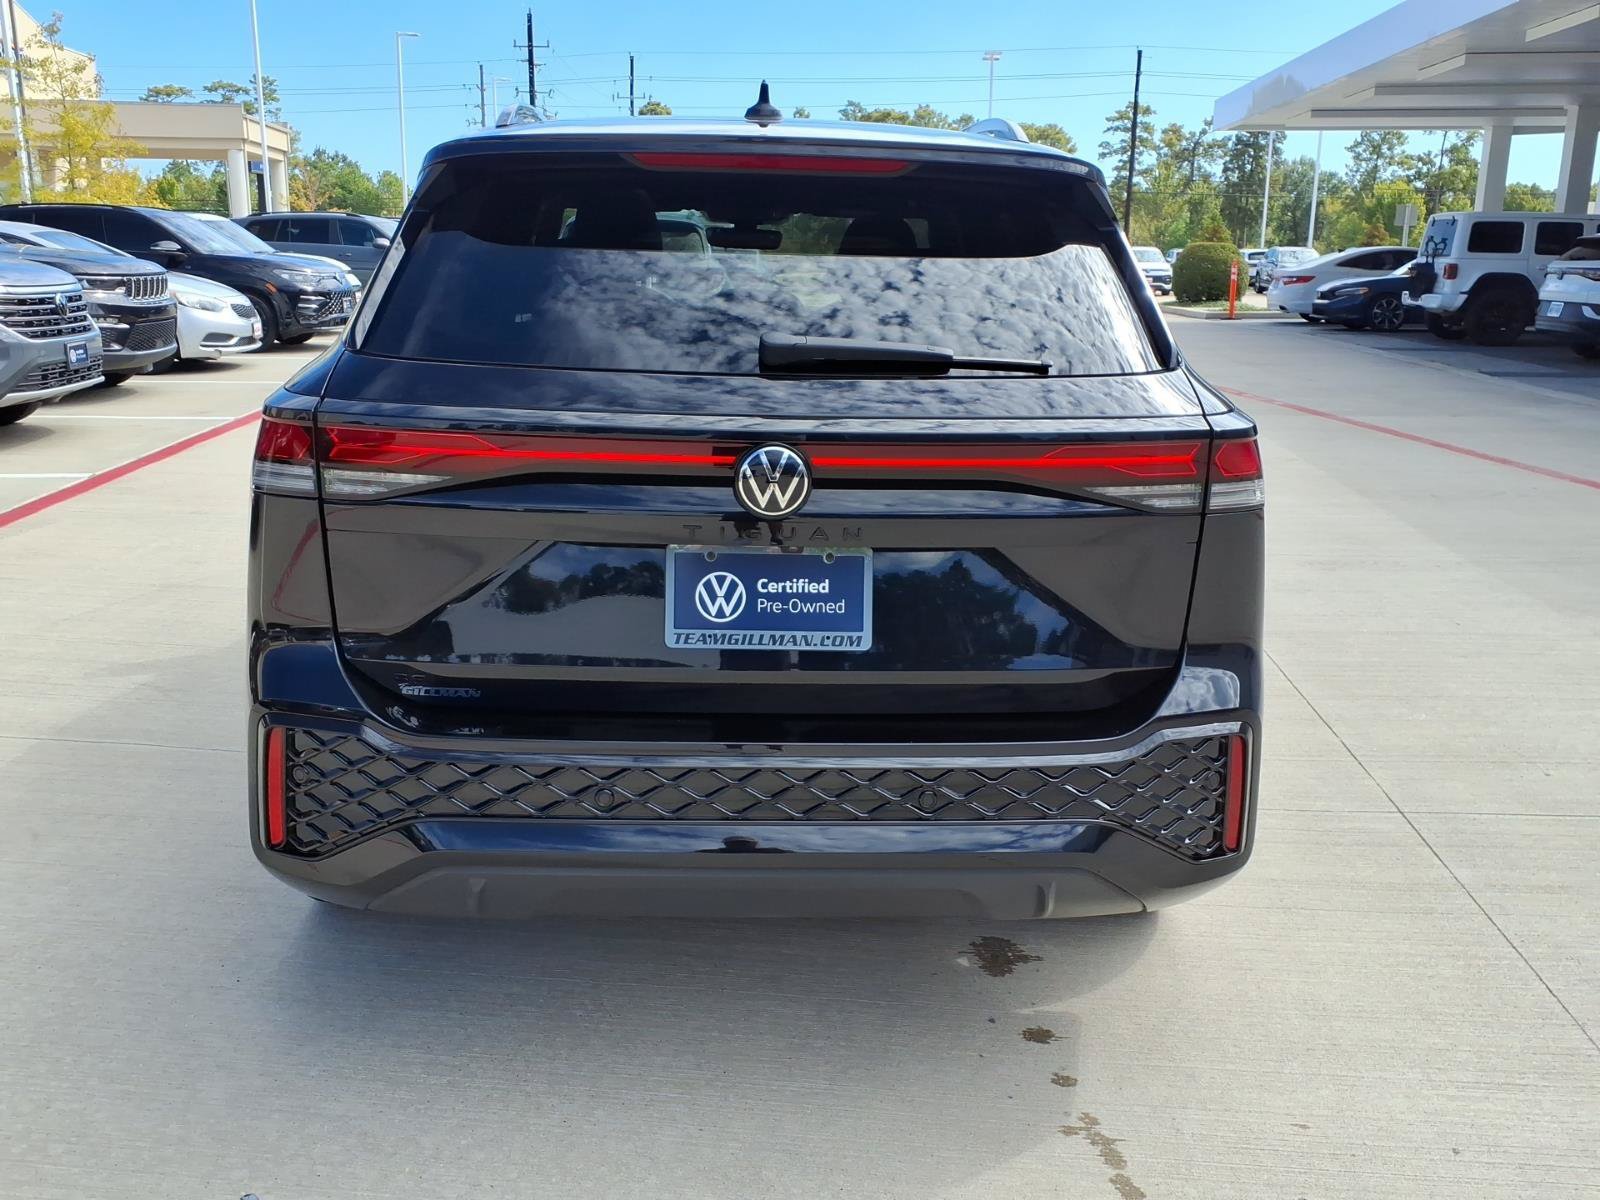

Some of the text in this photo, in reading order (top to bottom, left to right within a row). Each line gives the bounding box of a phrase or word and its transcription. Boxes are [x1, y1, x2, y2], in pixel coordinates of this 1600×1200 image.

[739, 446, 809, 516] VW
[683, 525, 864, 542] TIGUAN
[757, 578, 830, 594] Certified
[695, 571, 747, 623] VW
[757, 598, 846, 614] Pre-Owned
[673, 632, 863, 648] TEAMGILLMAN.COM
